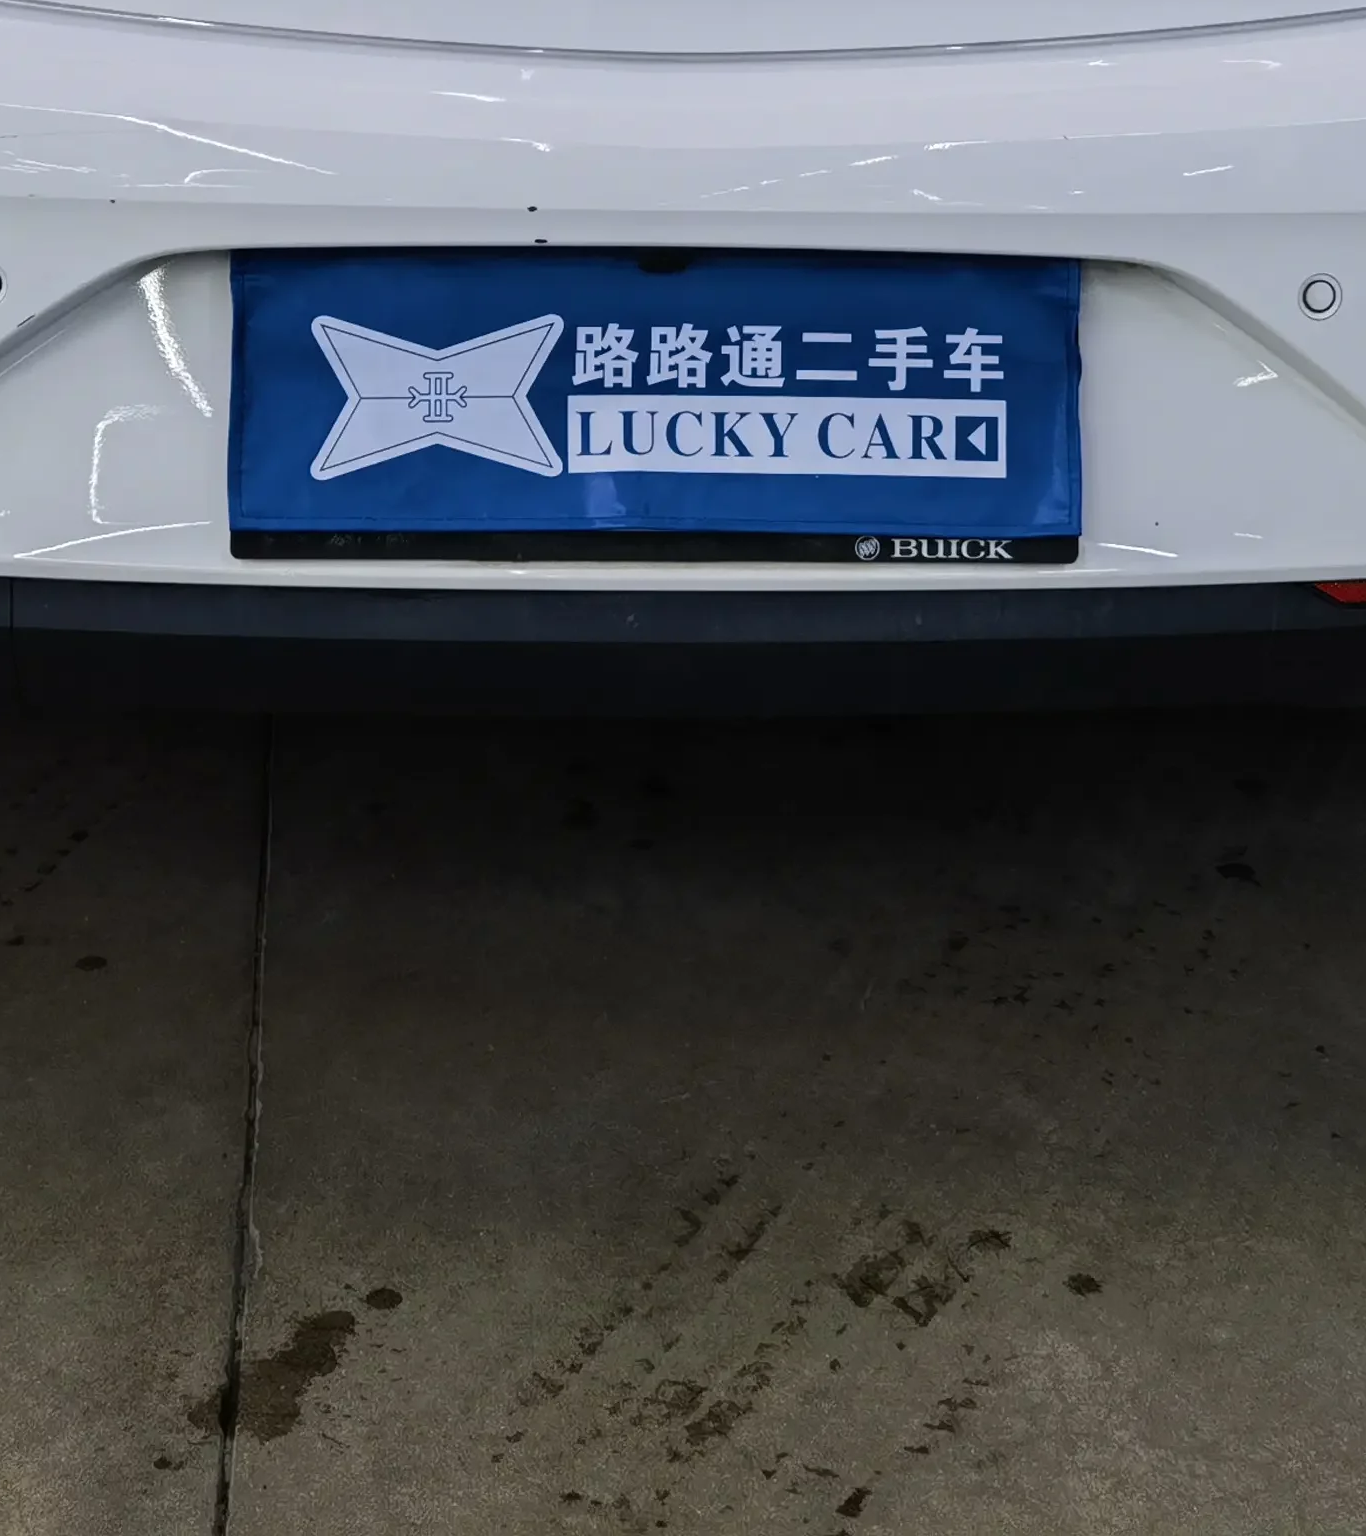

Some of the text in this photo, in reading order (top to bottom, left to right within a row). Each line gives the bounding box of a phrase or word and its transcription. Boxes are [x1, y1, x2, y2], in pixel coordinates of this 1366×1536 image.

[572, 323, 1004, 392] 路路通二手车
[576, 410, 948, 460] LUCKY CAR
[891, 538, 1014, 559] BUICK
